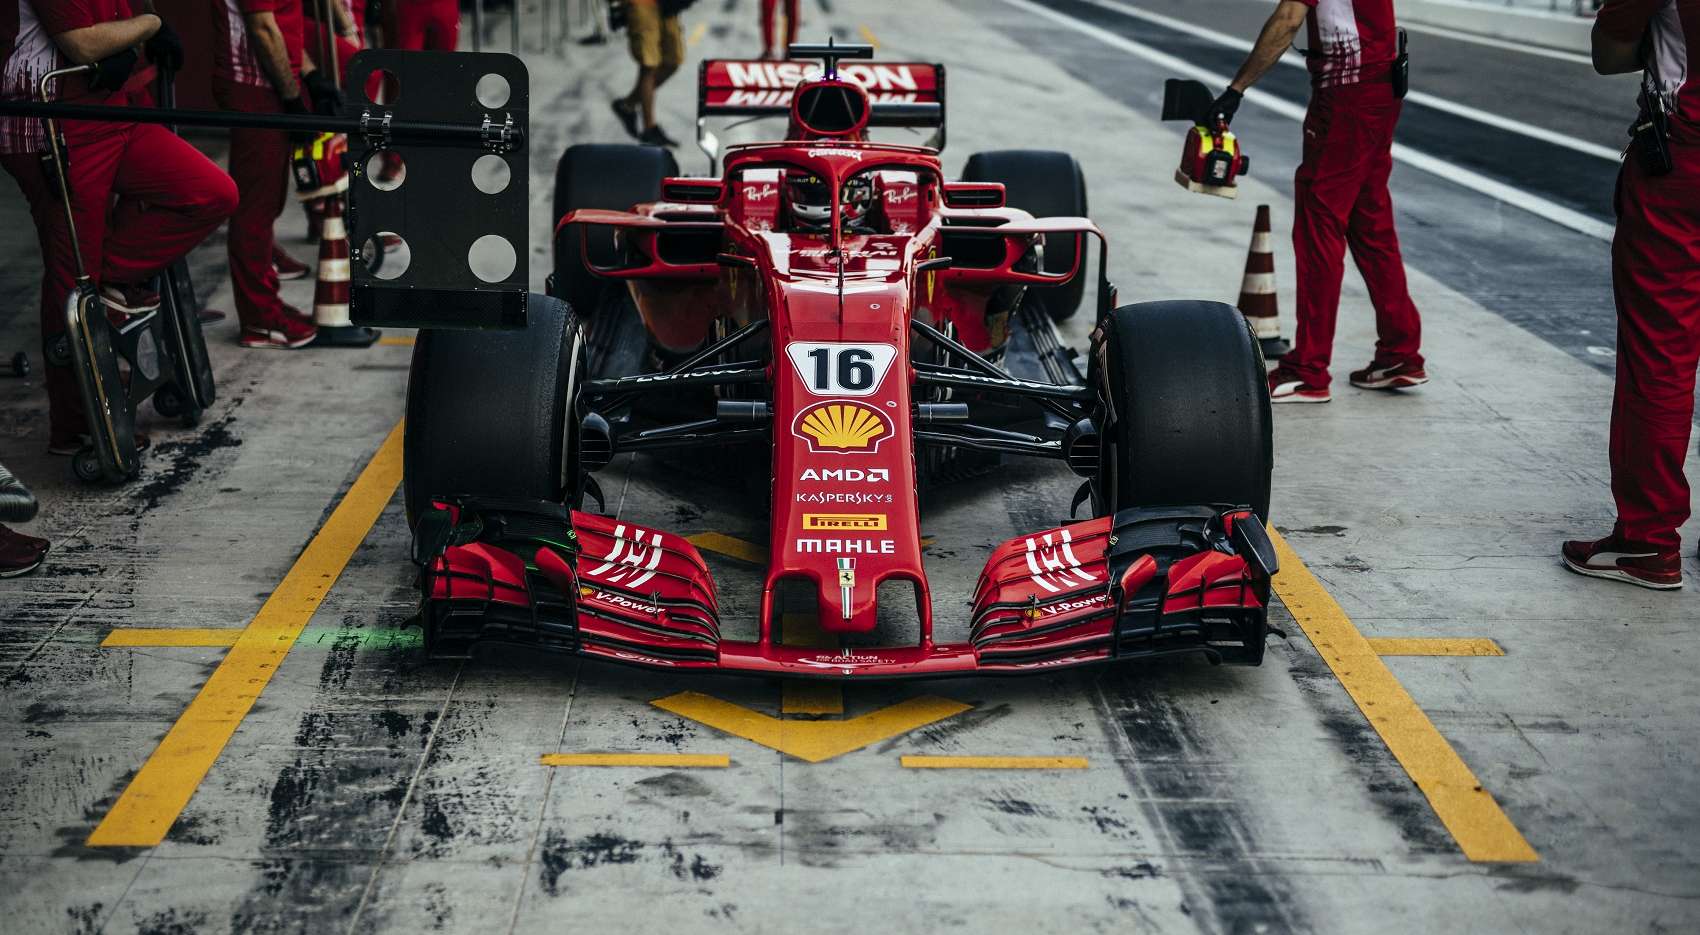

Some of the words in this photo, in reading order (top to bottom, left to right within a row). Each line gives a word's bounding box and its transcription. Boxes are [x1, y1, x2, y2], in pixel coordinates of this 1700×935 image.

[725, 62, 918, 90] MISON
[808, 347, 875, 391] 16
[800, 468, 865, 481] AMD
[796, 491, 884, 505] KASPERSKY
[809, 516, 879, 527] PIRELLI
[796, 538, 895, 554] MAHLE
[596, 591, 666, 613] V-Power
